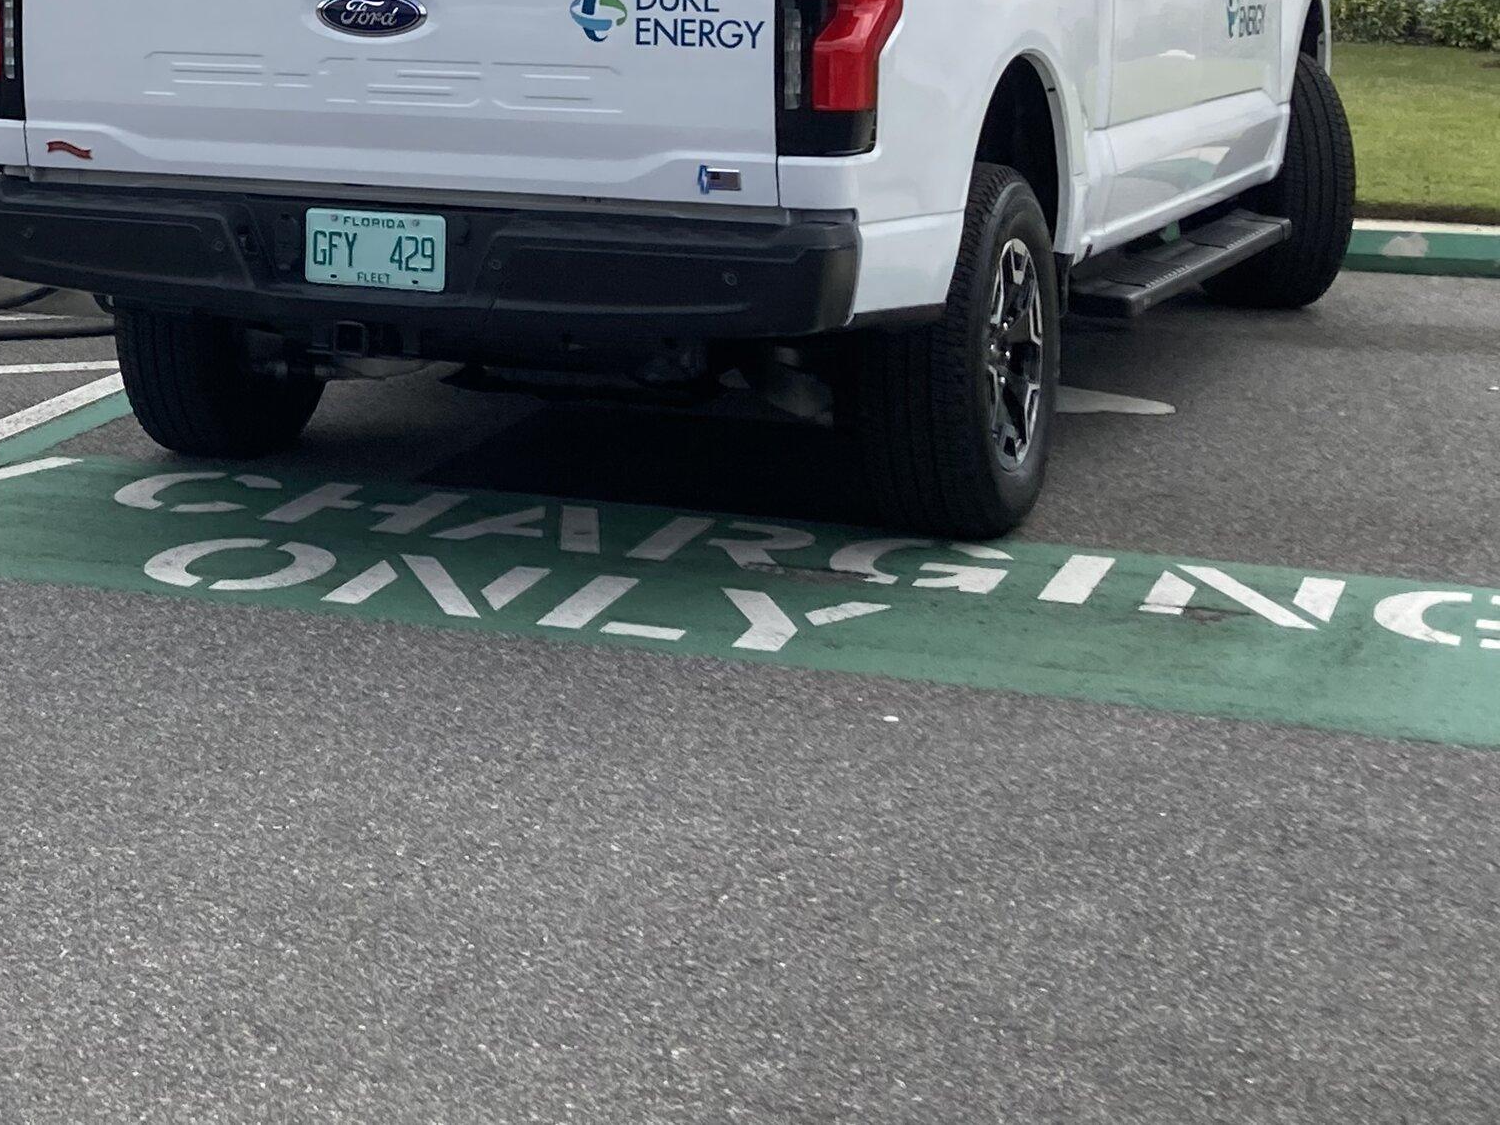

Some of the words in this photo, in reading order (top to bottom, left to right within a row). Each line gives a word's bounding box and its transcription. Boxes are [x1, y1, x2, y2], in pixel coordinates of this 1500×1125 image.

[635, 17, 766, 50] ENERGY
[1238, 3, 1267, 38] ENERGY
[343, 215, 406, 229] FLORIDA
[313, 230, 358, 268] GFY
[389, 235, 436, 273] 429
[356, 271, 391, 285] FLEET
[143, 537, 892, 652] ONLY
